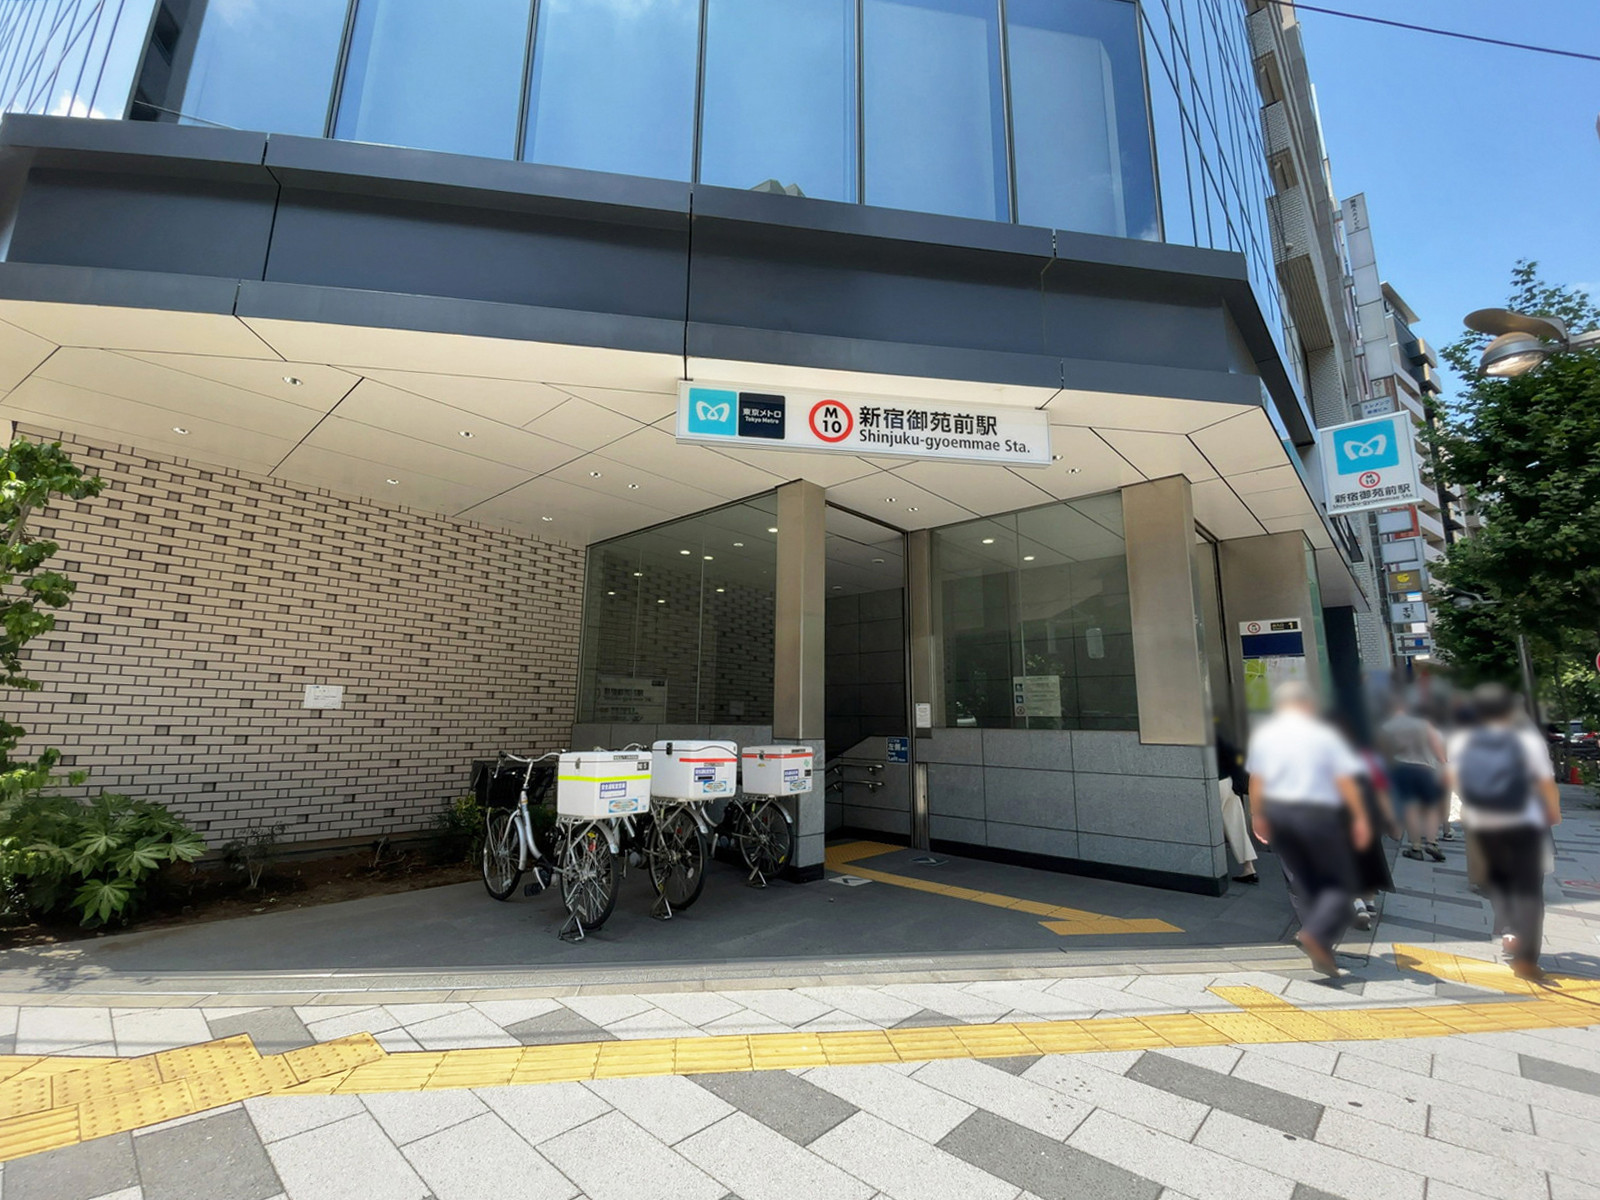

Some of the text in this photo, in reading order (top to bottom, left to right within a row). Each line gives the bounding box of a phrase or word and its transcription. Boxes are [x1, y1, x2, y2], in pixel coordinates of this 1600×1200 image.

[743, 408, 781, 418] 東京メトロ
[745, 416, 761, 424] Tokyo
[824, 407, 838, 419] M
[822, 420, 842, 434] 10
[859, 406, 997, 436] 新宿御苑前駅
[859, 430, 1031, 453] Shinjuku-gyoemmae Sta.
[1335, 483, 1411, 503] 新宿御苑前駅
